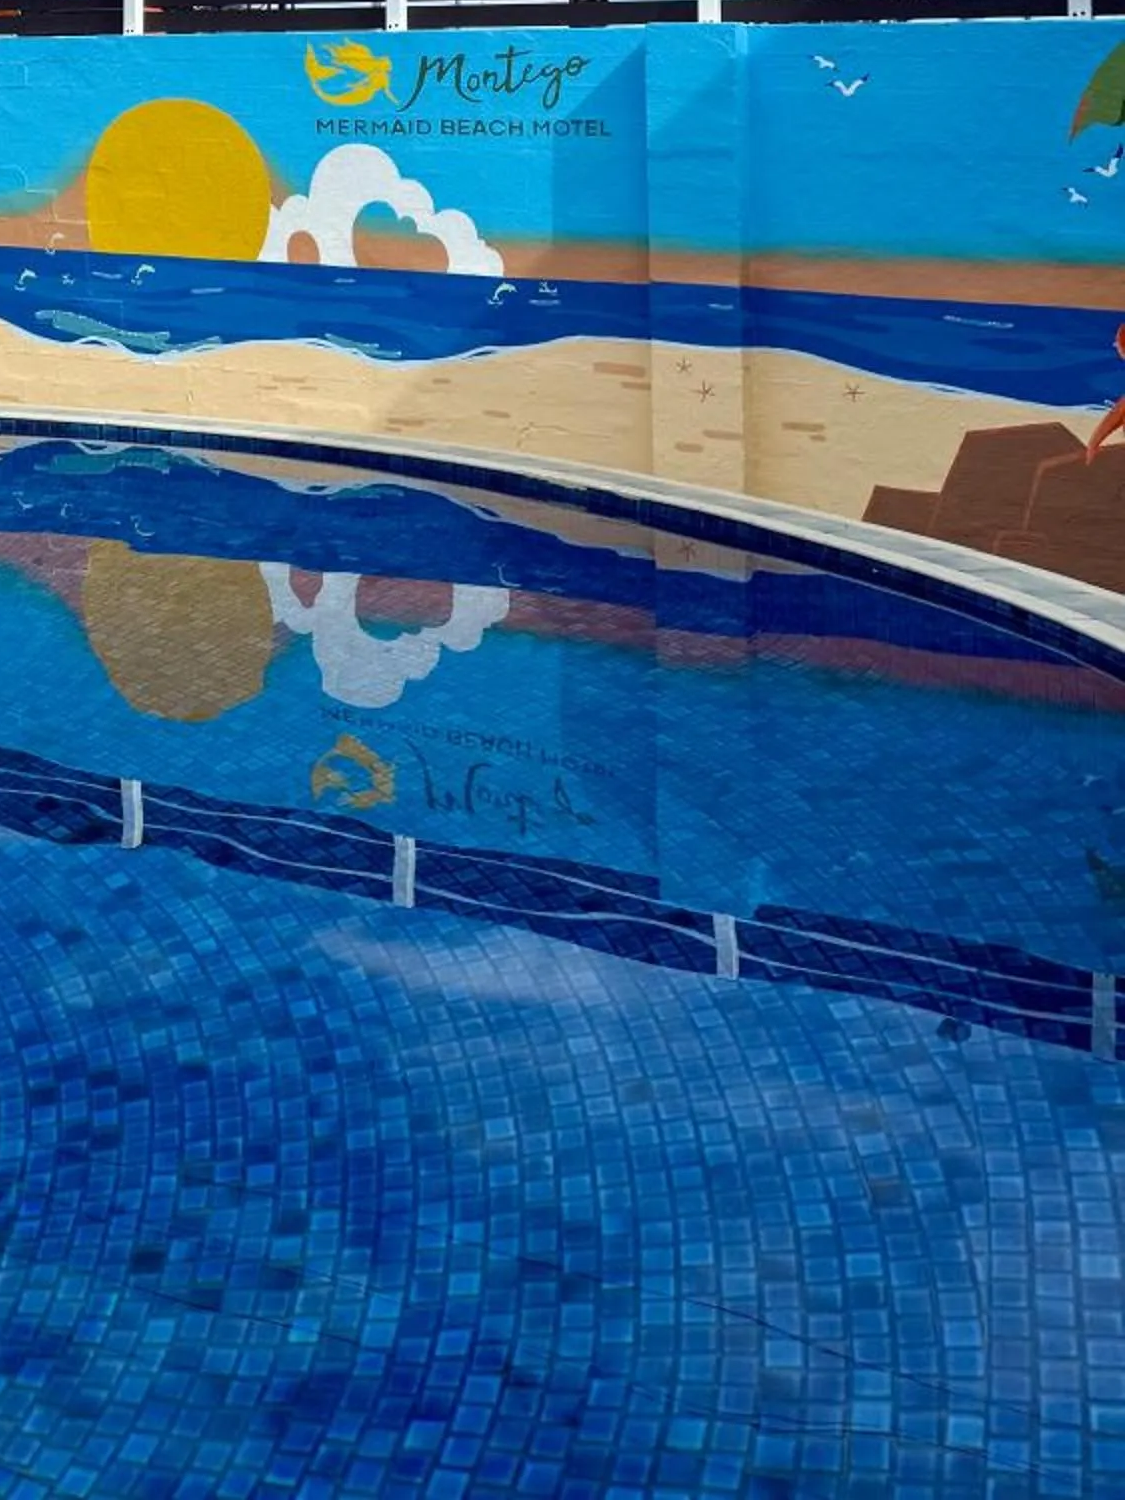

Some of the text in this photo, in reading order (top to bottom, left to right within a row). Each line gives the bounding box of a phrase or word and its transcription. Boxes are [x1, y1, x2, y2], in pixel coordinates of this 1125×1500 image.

[396, 44, 591, 112] Montego
[315, 118, 612, 137] MERMAID BEACH MOTEL
